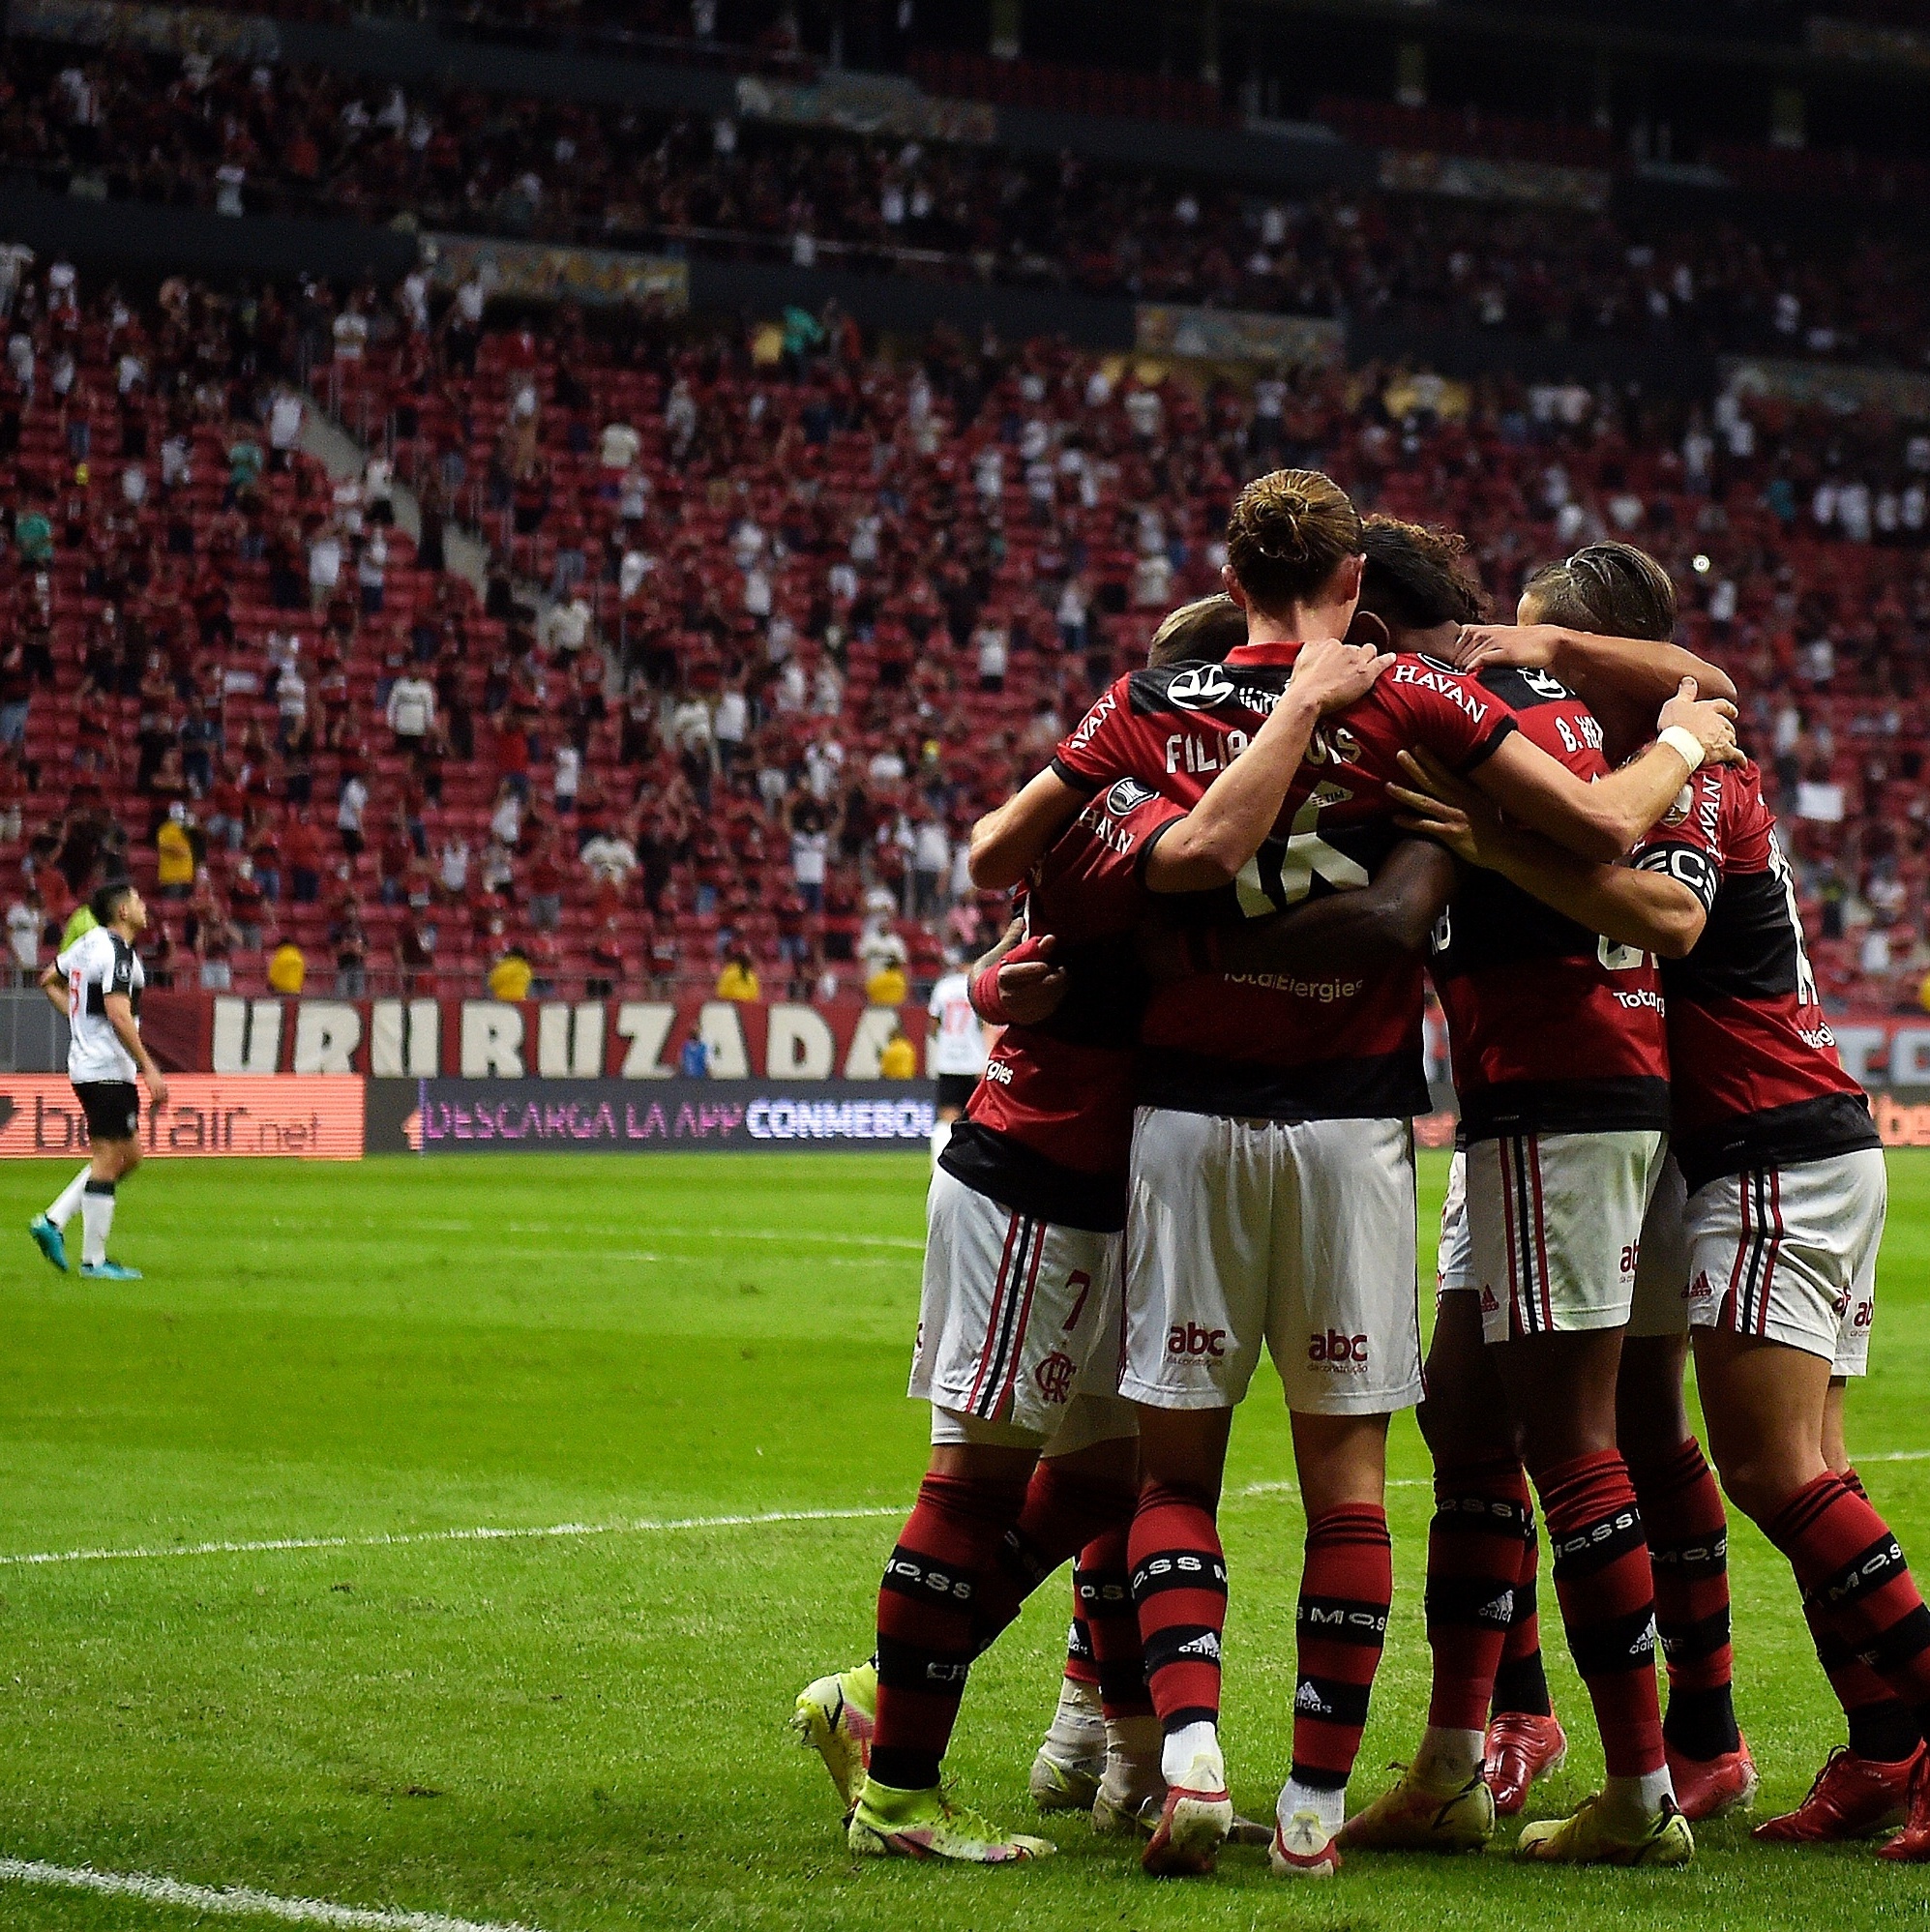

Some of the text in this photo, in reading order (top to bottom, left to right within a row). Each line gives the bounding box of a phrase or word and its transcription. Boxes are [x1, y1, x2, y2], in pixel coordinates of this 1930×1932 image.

[1392, 664, 1489, 724] HAVAN
[1166, 727, 1362, 774] FILIP UIS
[627, 1100, 668, 1139] LA
[1062, 1269, 1090, 1331] 7
[1168, 1322, 1226, 1356] abc
[1308, 1329, 1368, 1361] abc
